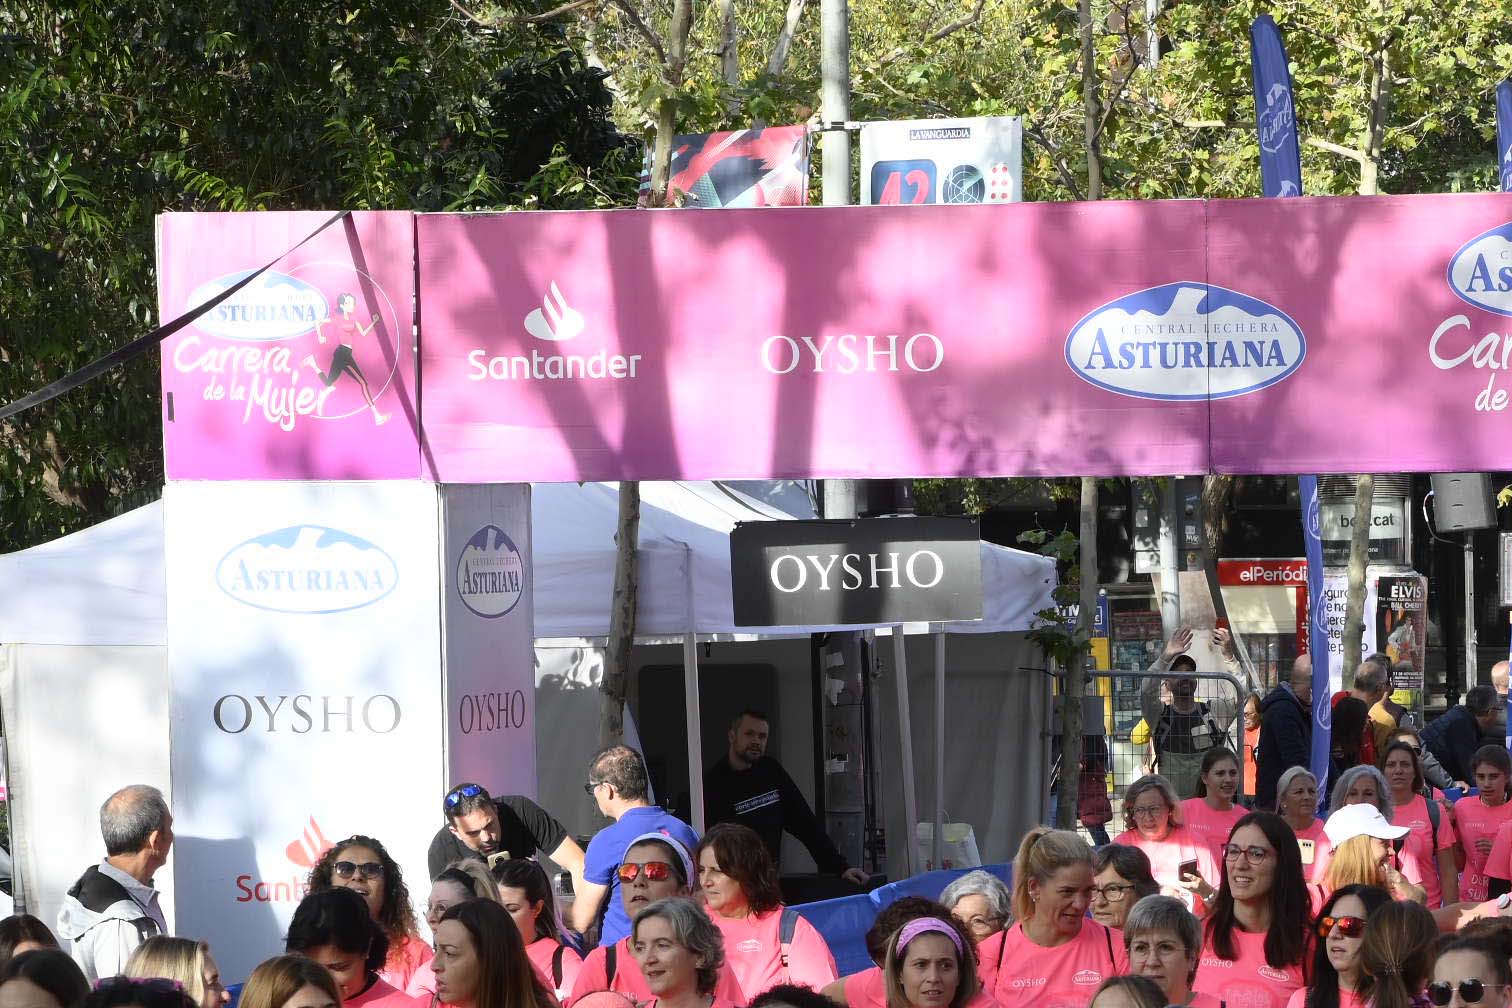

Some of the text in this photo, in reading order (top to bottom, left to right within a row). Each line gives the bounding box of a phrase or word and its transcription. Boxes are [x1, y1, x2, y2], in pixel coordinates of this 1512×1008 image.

[1120, 322, 1280, 335] CENTRAL LECHERA
[173, 336, 291, 373] Carrera
[468, 349, 642, 380] Santander
[760, 332, 944, 374] OYSHO
[1084, 327, 1288, 371] ASTURIANA
[203, 369, 336, 431] de la Mujer
[1474, 373, 1508, 411] de
[231, 560, 385, 591] ASTURIANA
[462, 559, 520, 595] ASTURIANA
[770, 549, 944, 593] OYSHO
[1391, 585, 1422, 598] ELVIS
[213, 694, 402, 734] OYSHO
[459, 689, 526, 735] OYSHO
[1202, 957, 1233, 968] OYSHO
[1012, 977, 1047, 987] OYSHO
